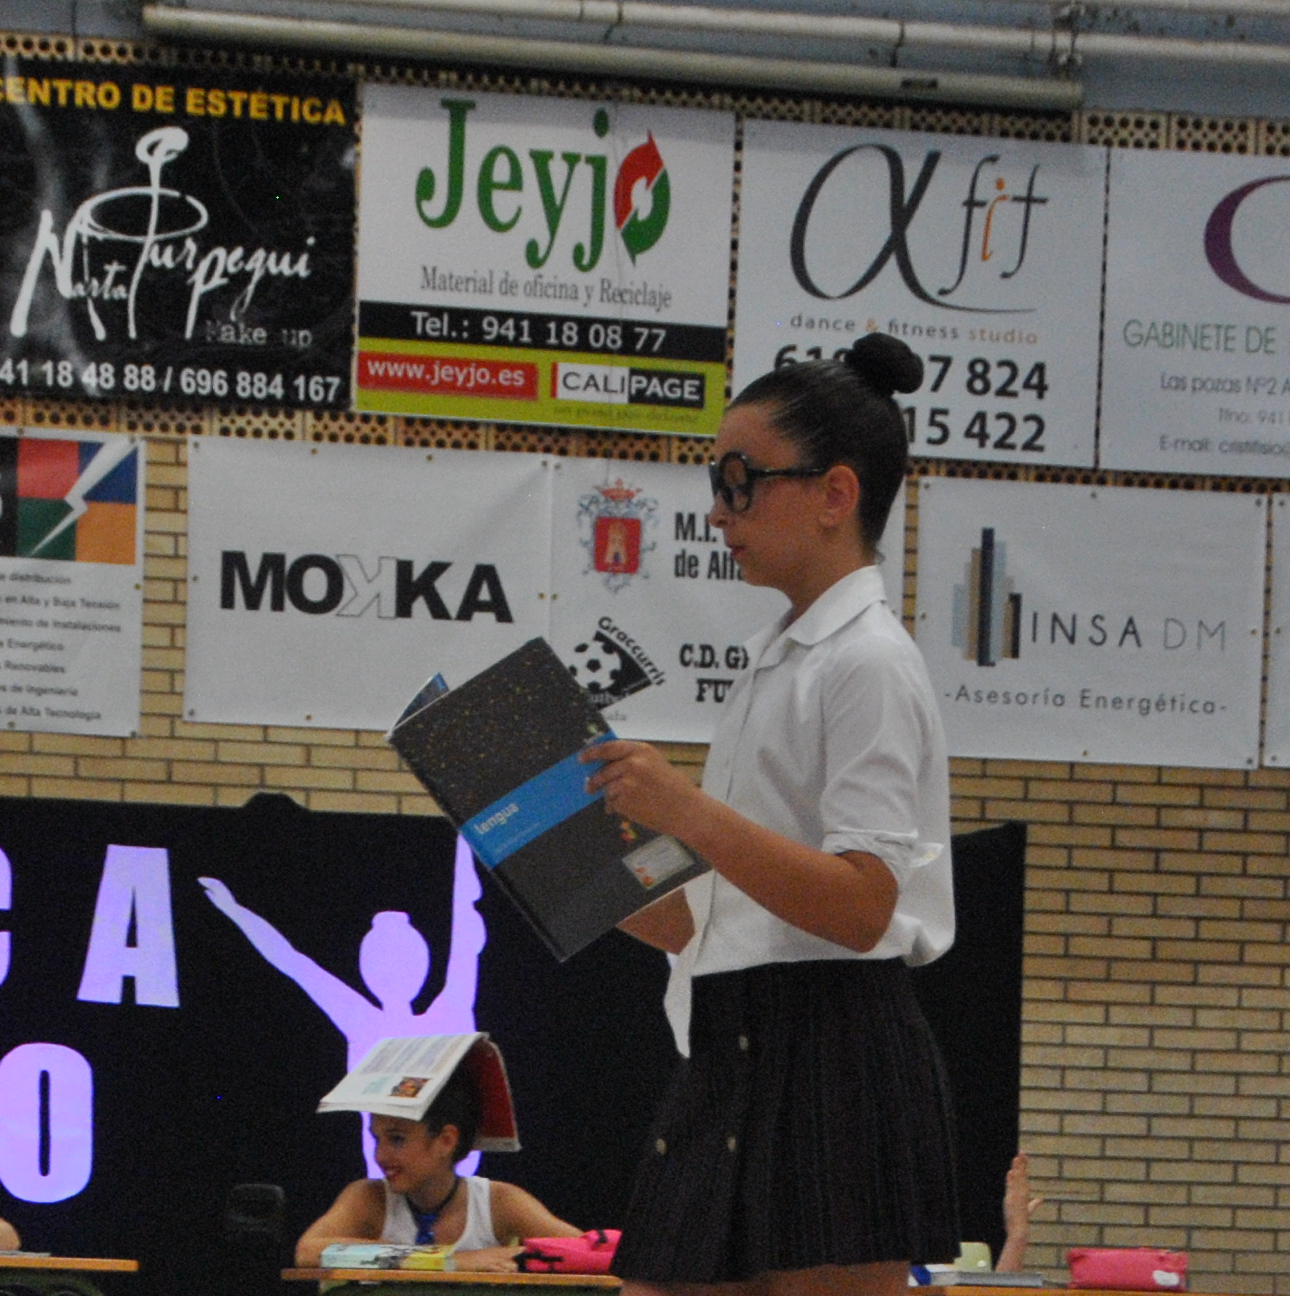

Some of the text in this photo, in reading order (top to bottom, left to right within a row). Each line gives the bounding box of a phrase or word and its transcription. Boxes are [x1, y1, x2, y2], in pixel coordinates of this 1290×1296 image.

[131, 85, 175, 113] DE
[415, 98, 671, 273] Jeyjo
[420, 265, 672, 312] Material de oficina y Reciclaje
[410, 310, 667, 352] Tel.: 941 18 08 77
[790, 312, 857, 333] dance
[887, 318, 960, 341] fitness
[967, 327, 1039, 346] studio
[1122, 318, 1237, 352] GABINETE
[1245, 326, 1277, 355] DE
[41, 360, 74, 389] 18
[81, 362, 116, 390] 48
[123, 364, 157, 392] 88
[180, 367, 229, 397] 696
[236, 371, 284, 400] 884
[293, 374, 341, 402] 167
[367, 359, 526, 387] www.jeyjo.es
[965, 357, 1050, 401] 824
[963, 410, 1047, 453] 422
[674, 547, 700, 579] de
[1030, 611, 1227, 652] INSA DM
[679, 643, 721, 669] C.D.
